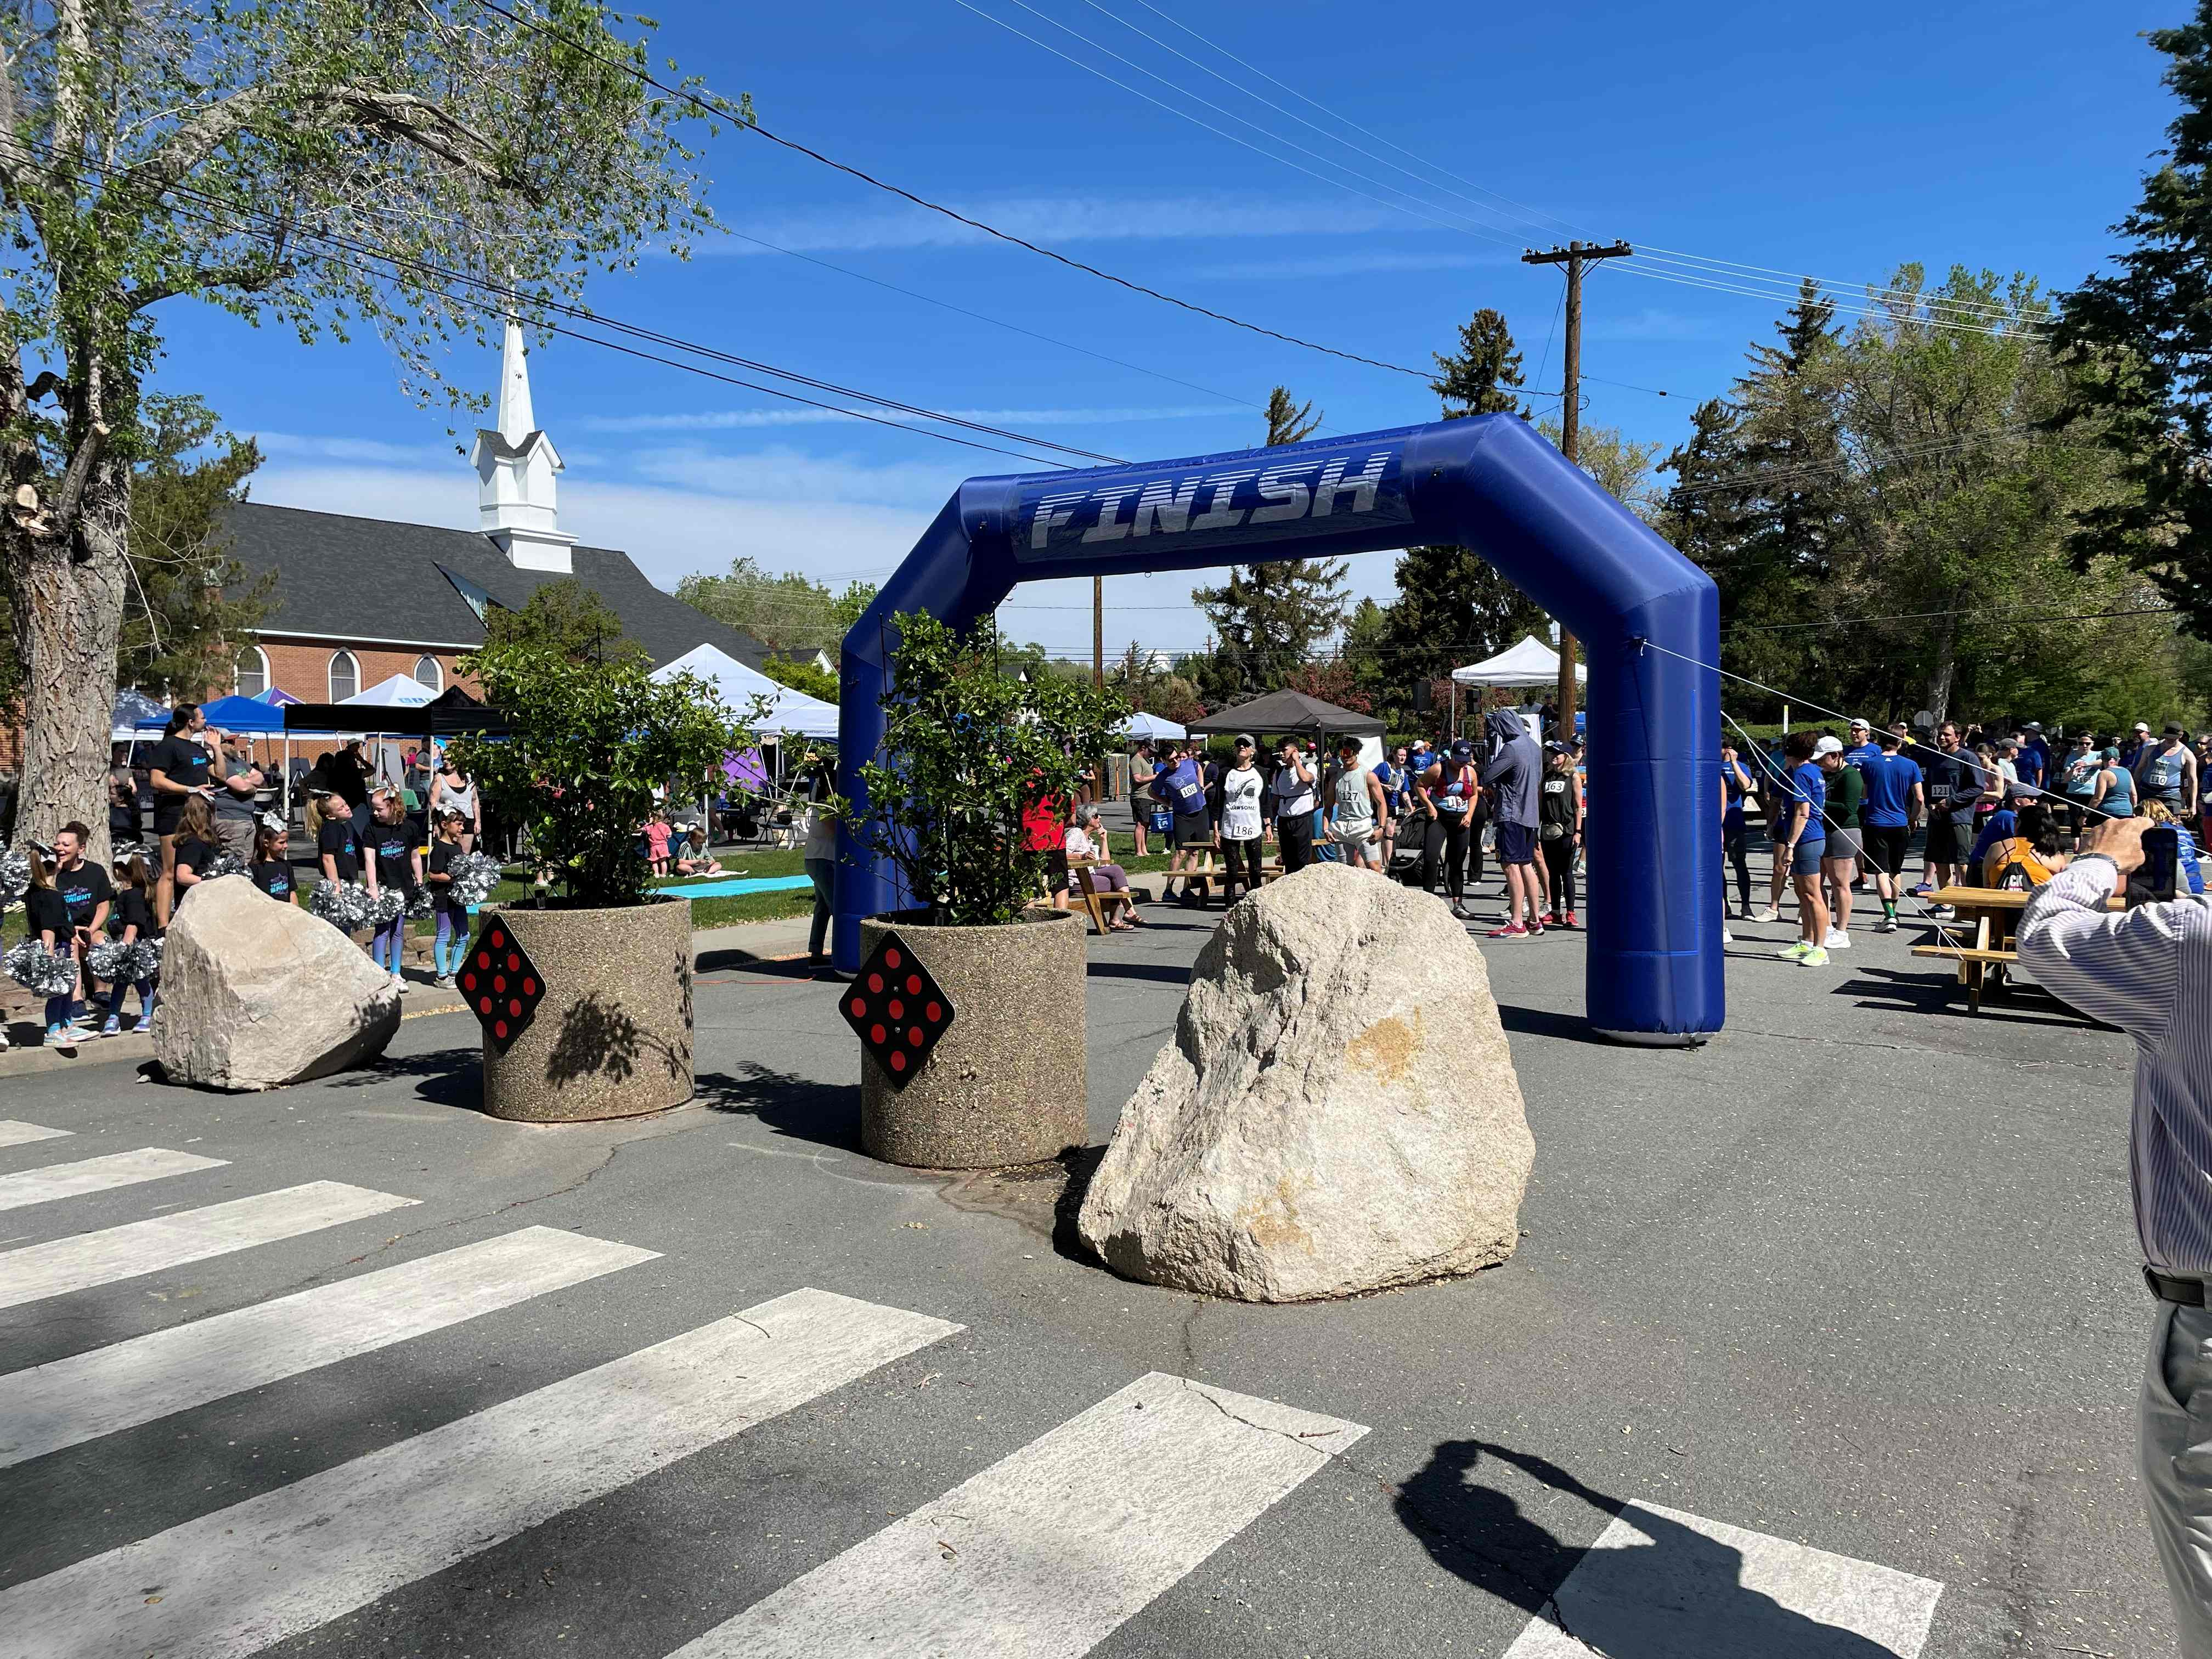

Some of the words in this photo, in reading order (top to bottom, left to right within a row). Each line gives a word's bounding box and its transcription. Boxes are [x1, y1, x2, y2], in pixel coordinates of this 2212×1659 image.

[1031, 452, 1392, 549] FINISH
[1547, 782, 1562, 791] 163
[1933, 786, 1948, 795] 121
[1342, 792, 1358, 800] 127
[1235, 826, 1253, 836] 186
[381, 846, 406, 855] BRIGHT
